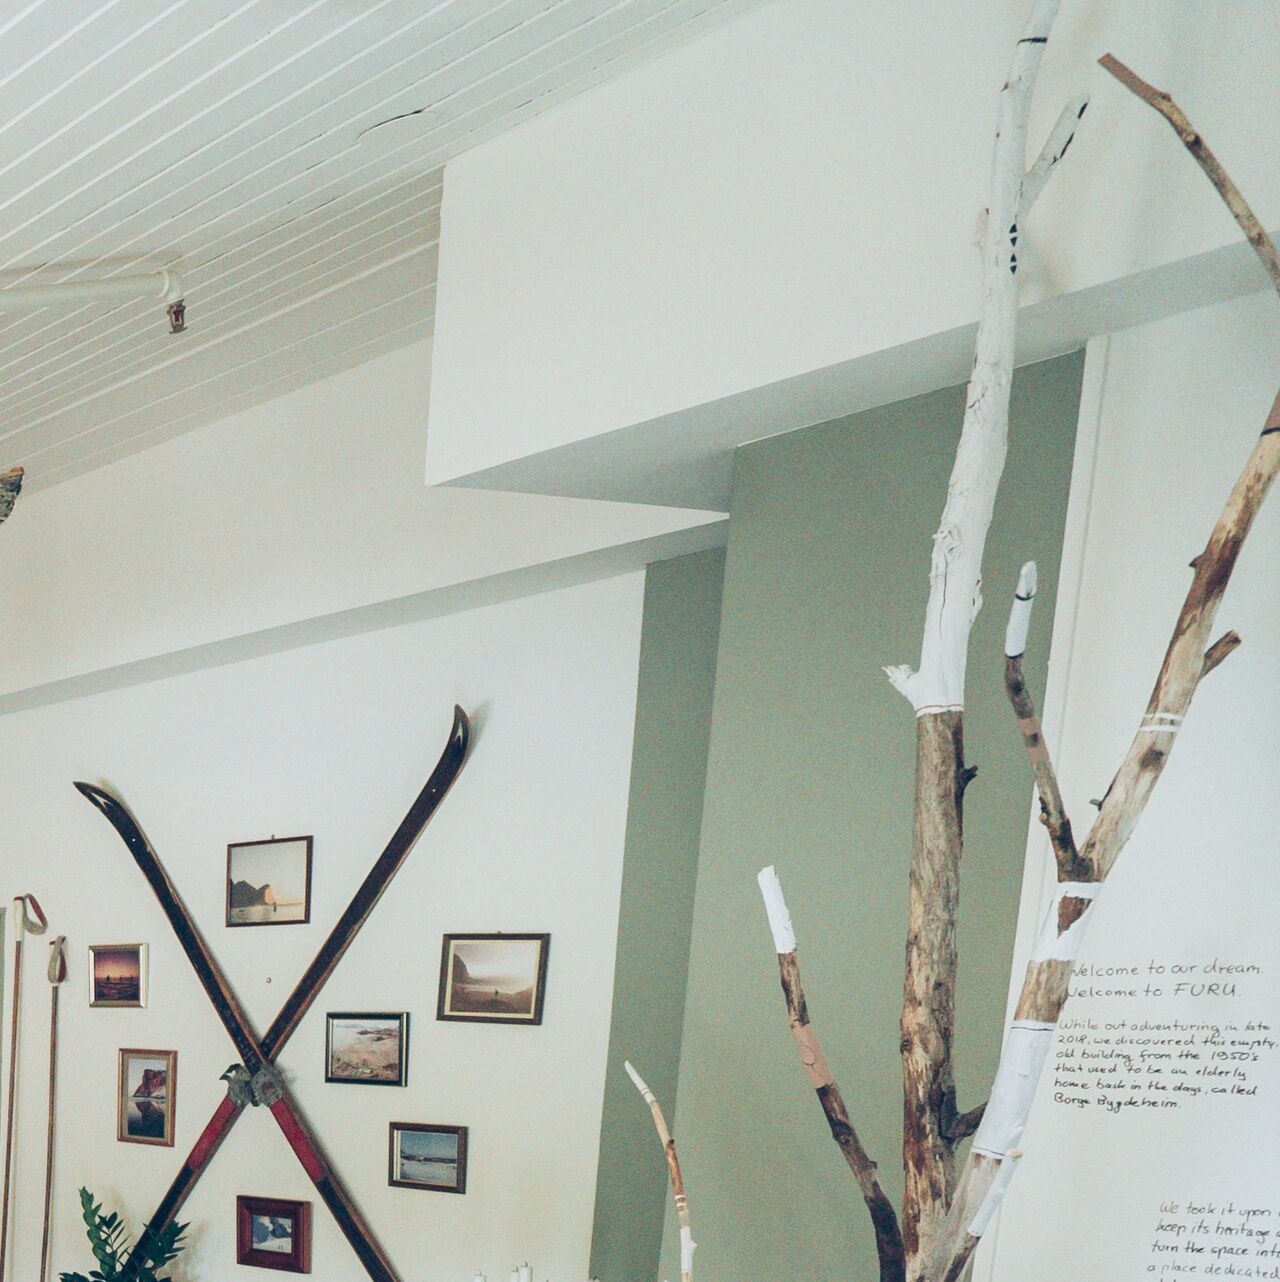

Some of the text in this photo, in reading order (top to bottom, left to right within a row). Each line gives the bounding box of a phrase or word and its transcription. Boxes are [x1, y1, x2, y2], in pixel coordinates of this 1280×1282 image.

[1148, 959, 1165, 975] to
[1171, 963, 1198, 974] our
[1143, 983, 1163, 996] to
[1059, 1018, 1270, 1037] While out adventuring in late
[1094, 1037, 1111, 1045] we
[1115, 1034, 1195, 1046] discovered
[1202, 1034, 1225, 1046] this
[1056, 1049, 1259, 1067] old building from the 1950's
[1054, 1062, 1083, 1074] that
[1087, 1062, 1118, 1074] used
[1127, 1063, 1142, 1074] to
[1147, 1064, 1163, 1074] be
[1195, 1065, 1247, 1081] elderly
[1054, 1077, 1090, 1089] home
[1096, 1078, 1126, 1089] back
[1130, 1080, 1142, 1090] in
[1148, 1080, 1169, 1091] the
[1210, 1084, 1258, 1096] called
[1159, 1201, 1179, 1214] We
[1186, 1200, 1215, 1214] took
[1221, 1201, 1234, 1215] it
[1239, 1208, 1272, 1222] upon
[1155, 1218, 1270, 1244] keep its heritage
[1151, 1239, 1179, 1253] turn
[1184, 1240, 1205, 1254] the
[1210, 1246, 1249, 1259] space
[1146, 1260, 1280, 1280] a place dedicated
